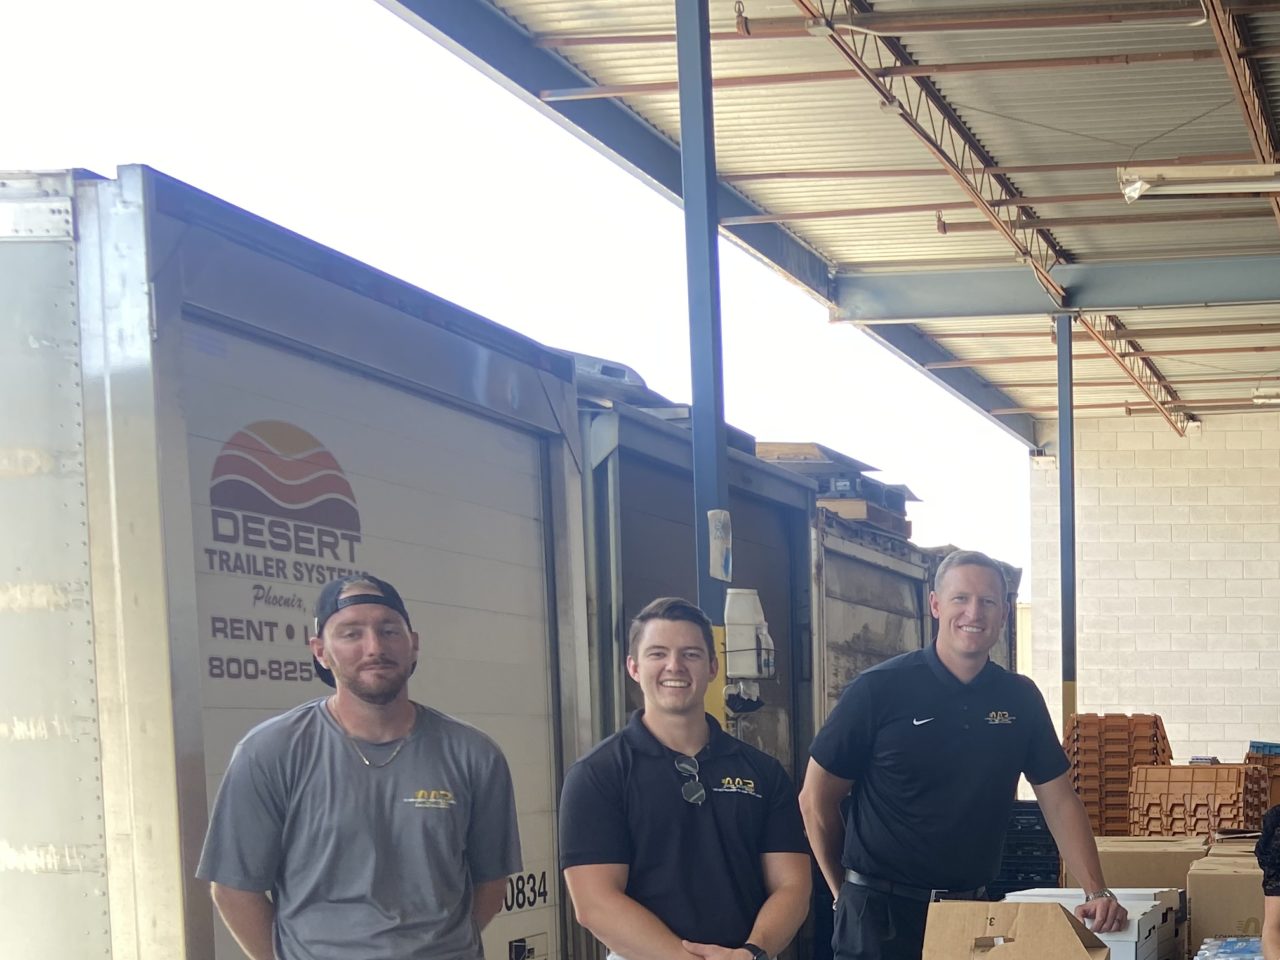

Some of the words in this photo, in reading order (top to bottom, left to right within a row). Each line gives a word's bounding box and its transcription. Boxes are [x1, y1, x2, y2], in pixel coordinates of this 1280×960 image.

[211, 509, 362, 564] DESERT
[204, 548, 288, 580] TRAILER
[211, 616, 279, 642] RENT
